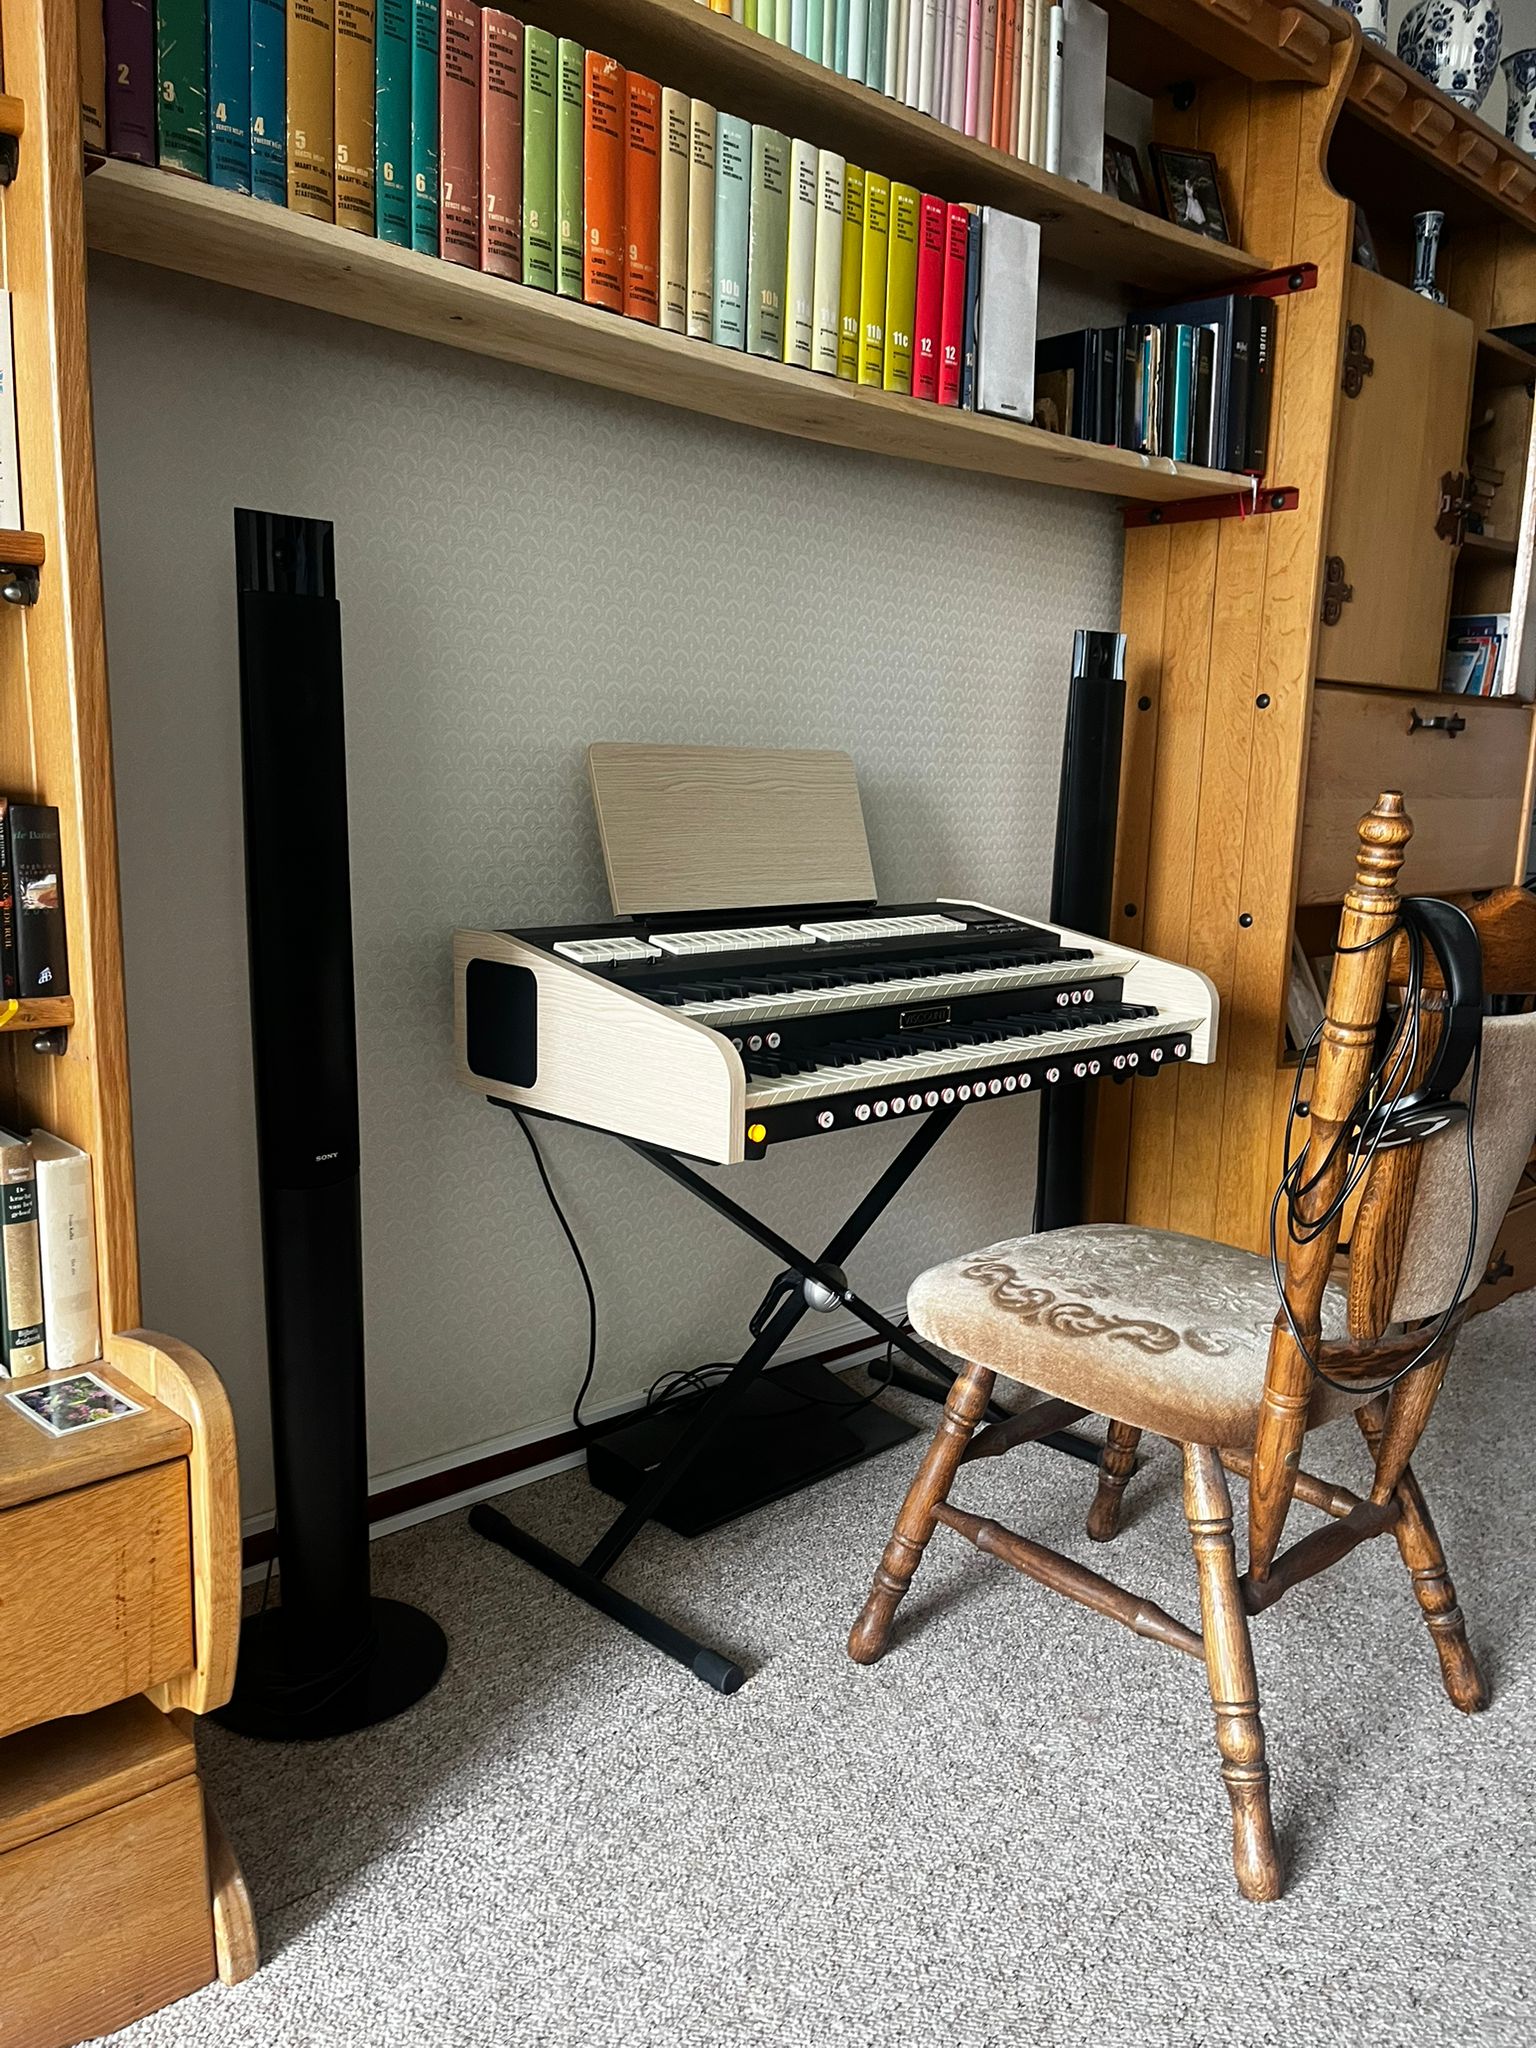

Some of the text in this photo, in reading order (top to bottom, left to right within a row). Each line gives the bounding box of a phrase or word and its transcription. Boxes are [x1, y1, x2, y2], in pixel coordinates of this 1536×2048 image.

[117, 63, 130, 86] 2
[162, 80, 176, 102] 3
[215, 102, 227, 122] 4
[253, 116, 265, 136] 4
[294, 129, 306, 150] 5
[337, 144, 348, 164] 5
[383, 162, 394, 181] 6
[415, 173, 426, 192] 6
[444, 182, 453, 201] 7
[487, 194, 496, 213] 7
[562, 220, 570, 238] 8
[591, 228, 600, 246] 9
[629, 244, 638, 261] 9
[842, 315, 858, 334] 11b
[892, 330, 909, 348] 11c
[921, 337, 932, 353] 12
[1258, 325, 1268, 364] BIJBEL
[944, 344, 956, 361] 12
[315, 1152, 338, 1162] SONY
